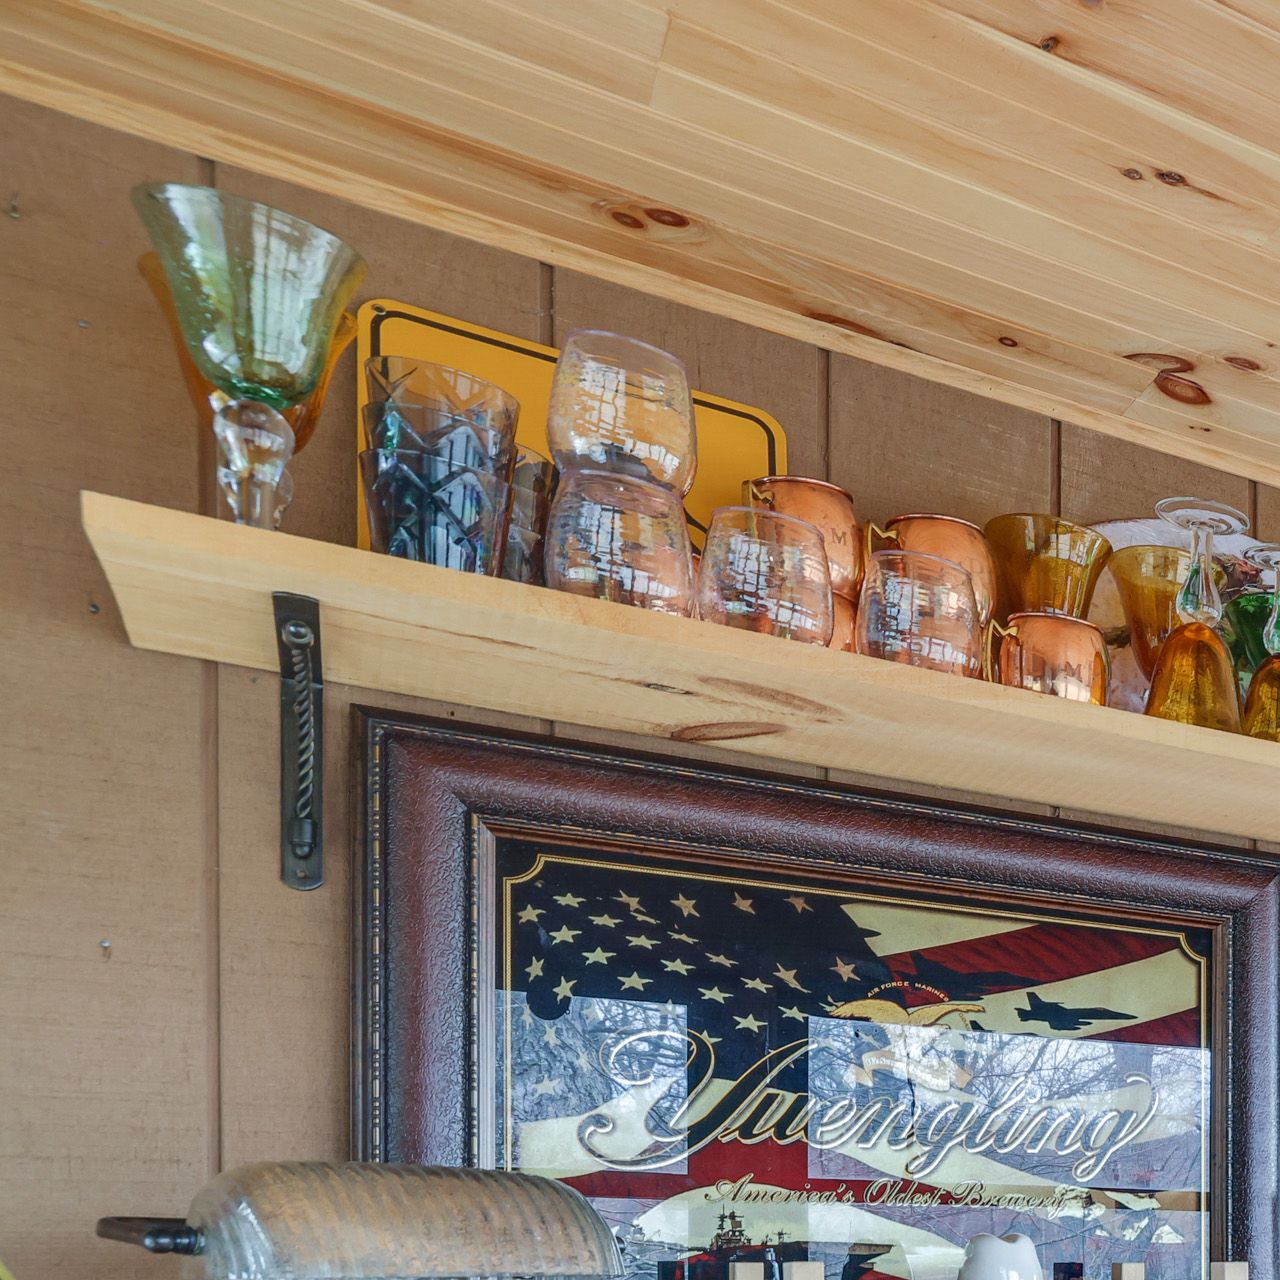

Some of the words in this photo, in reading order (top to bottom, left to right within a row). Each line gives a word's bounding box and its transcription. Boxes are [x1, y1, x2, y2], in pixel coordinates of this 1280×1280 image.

[830, 526, 848, 547] M
[1065, 661, 1083, 683] M
[867, 986, 880, 998] AIR
[881, 981, 910, 991] FORCE
[915, 982, 950, 1002] MARINES
[577, 1024, 1162, 1182] Yuengling
[704, 1173, 856, 1207] America's
[863, 1178, 946, 1208] Oldest
[947, 1179, 1069, 1220] Brewery
